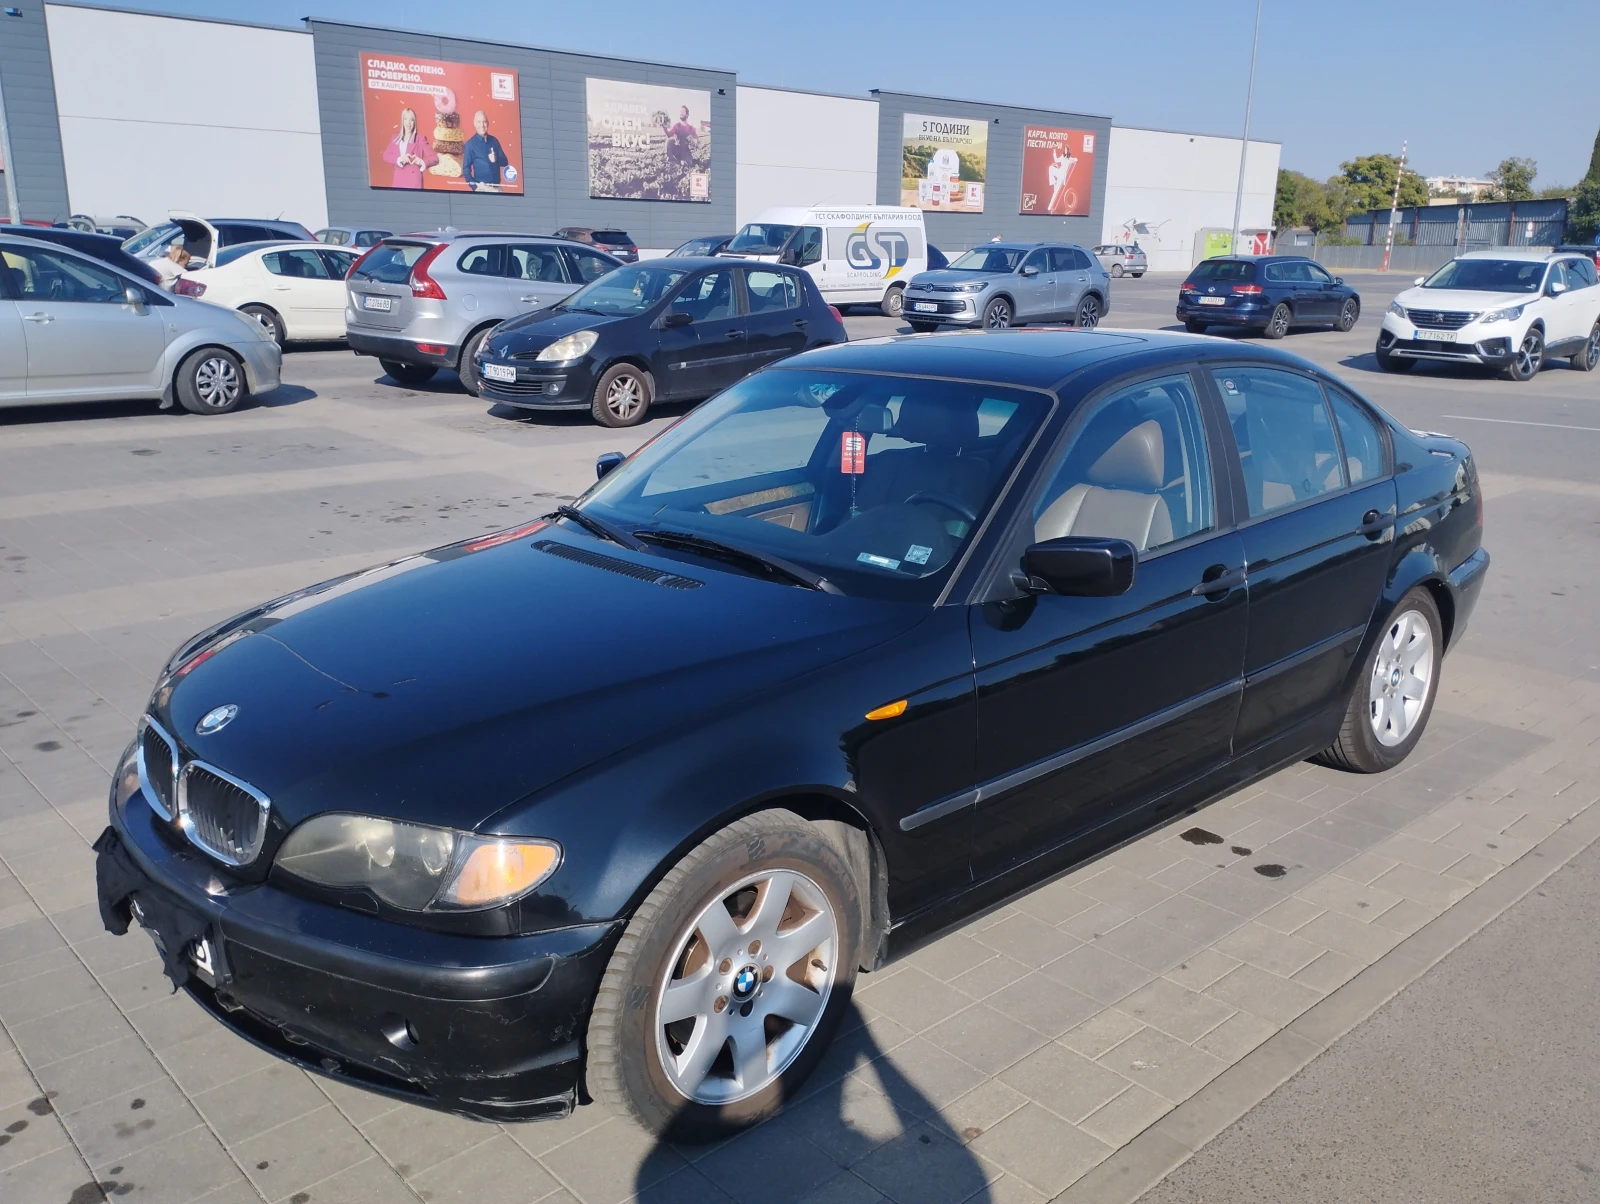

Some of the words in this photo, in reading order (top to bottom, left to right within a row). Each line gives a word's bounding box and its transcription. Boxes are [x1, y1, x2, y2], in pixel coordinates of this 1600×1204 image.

[367, 59, 407, 72] СЛАДКО.
[408, 64, 446, 76] СОЛЕНО.
[368, 69, 423, 83] ПРОВЕРЕНО.
[381, 82, 415, 91] KAUFLAND
[415, 85, 445, 94] ПЕКАРНА
[592, 113, 642, 133] РОДЕН
[922, 121, 928, 132] 5
[929, 122, 970, 136] ГОДИНИ
[612, 132, 650, 149] ВКУС!
[933, 135, 942, 143] НА
[942, 136, 973, 145] БЪЛГАРСКО
[1027, 129, 1048, 140] КАРТА,
[1049, 131, 1069, 141] КОЯТО
[1026, 139, 1046, 149] ПЕСТИ
[826, 213, 872, 221] СКАФОЛДИНГ
[873, 213, 904, 221] БЪЛГАРИЯ
[846, 271, 882, 279] SCAFFOLDING
[1418, 331, 1427, 339] CT
[1428, 332, 1445, 340] 7162
[1446, 333, 1455, 341] TK
